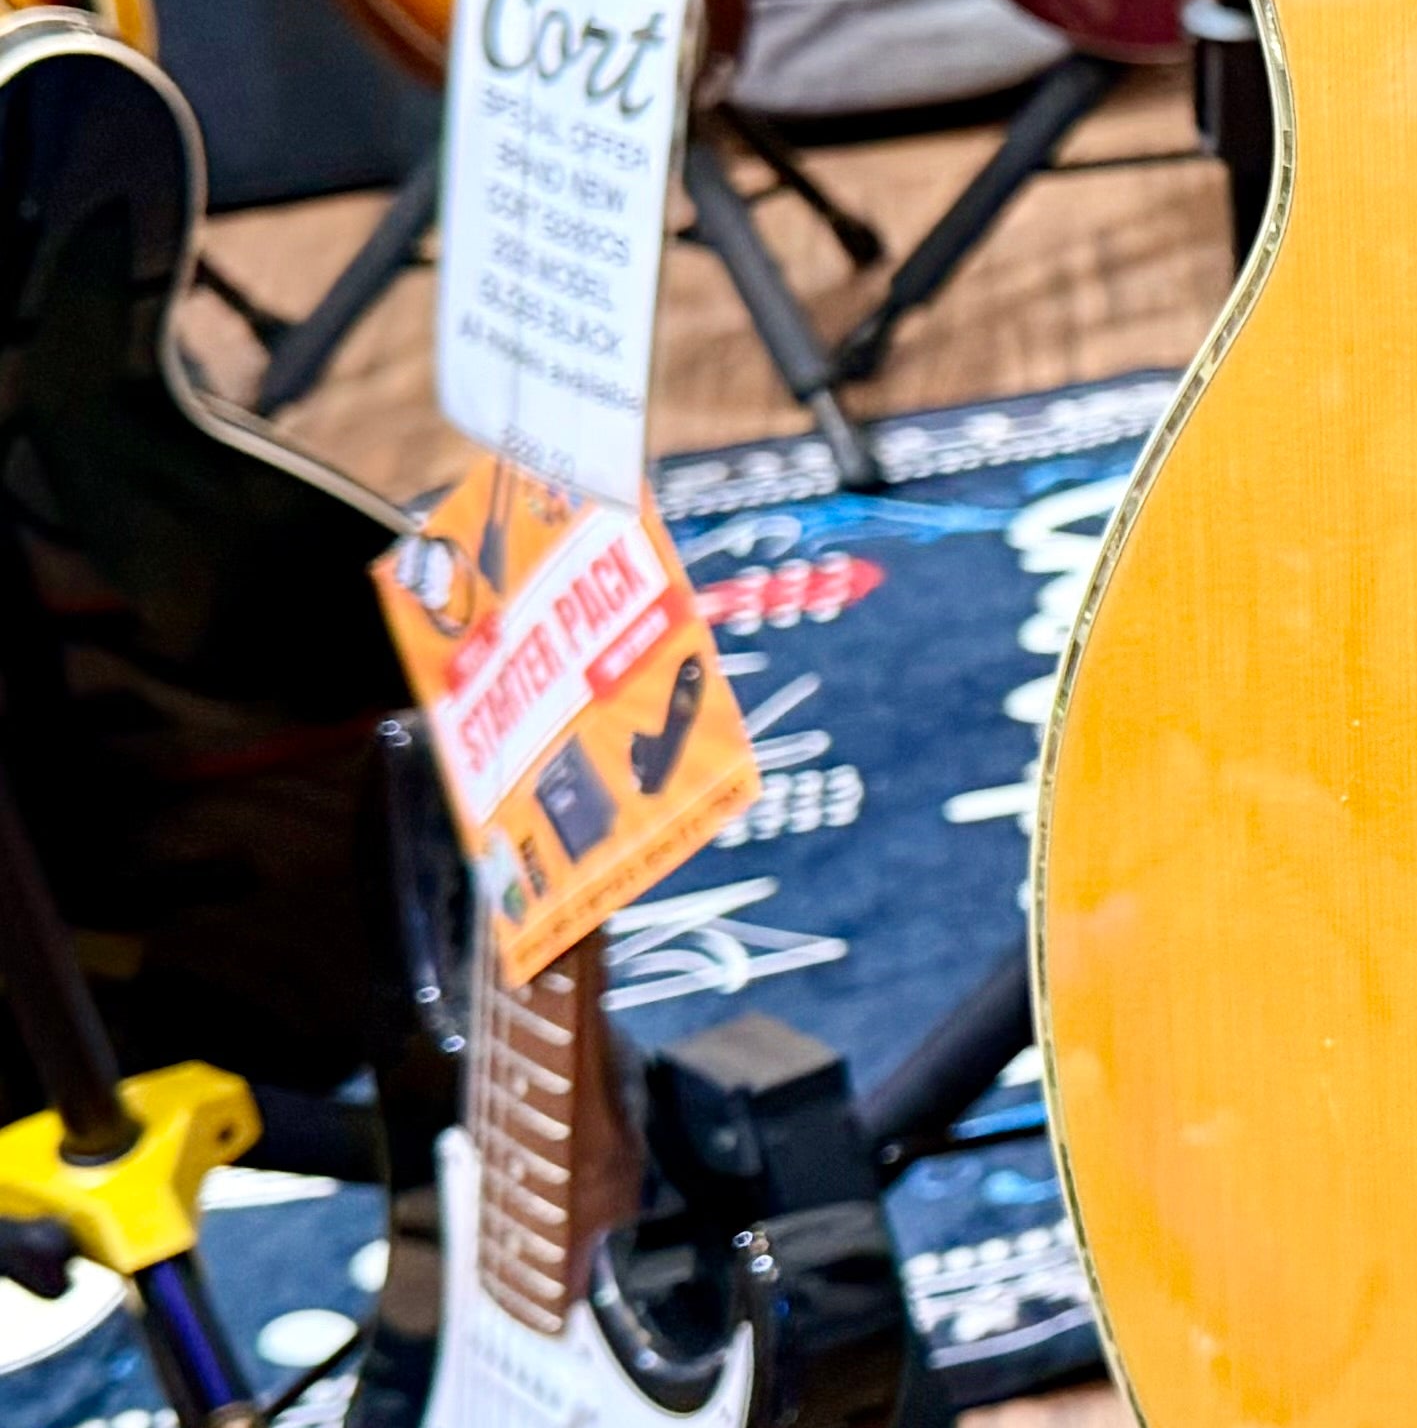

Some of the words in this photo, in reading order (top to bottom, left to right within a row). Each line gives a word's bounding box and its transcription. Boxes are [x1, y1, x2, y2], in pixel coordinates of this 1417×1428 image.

[570, 172, 628, 214] NEW
[458, 623, 565, 774] STARTER
[553, 538, 649, 658] PACK
